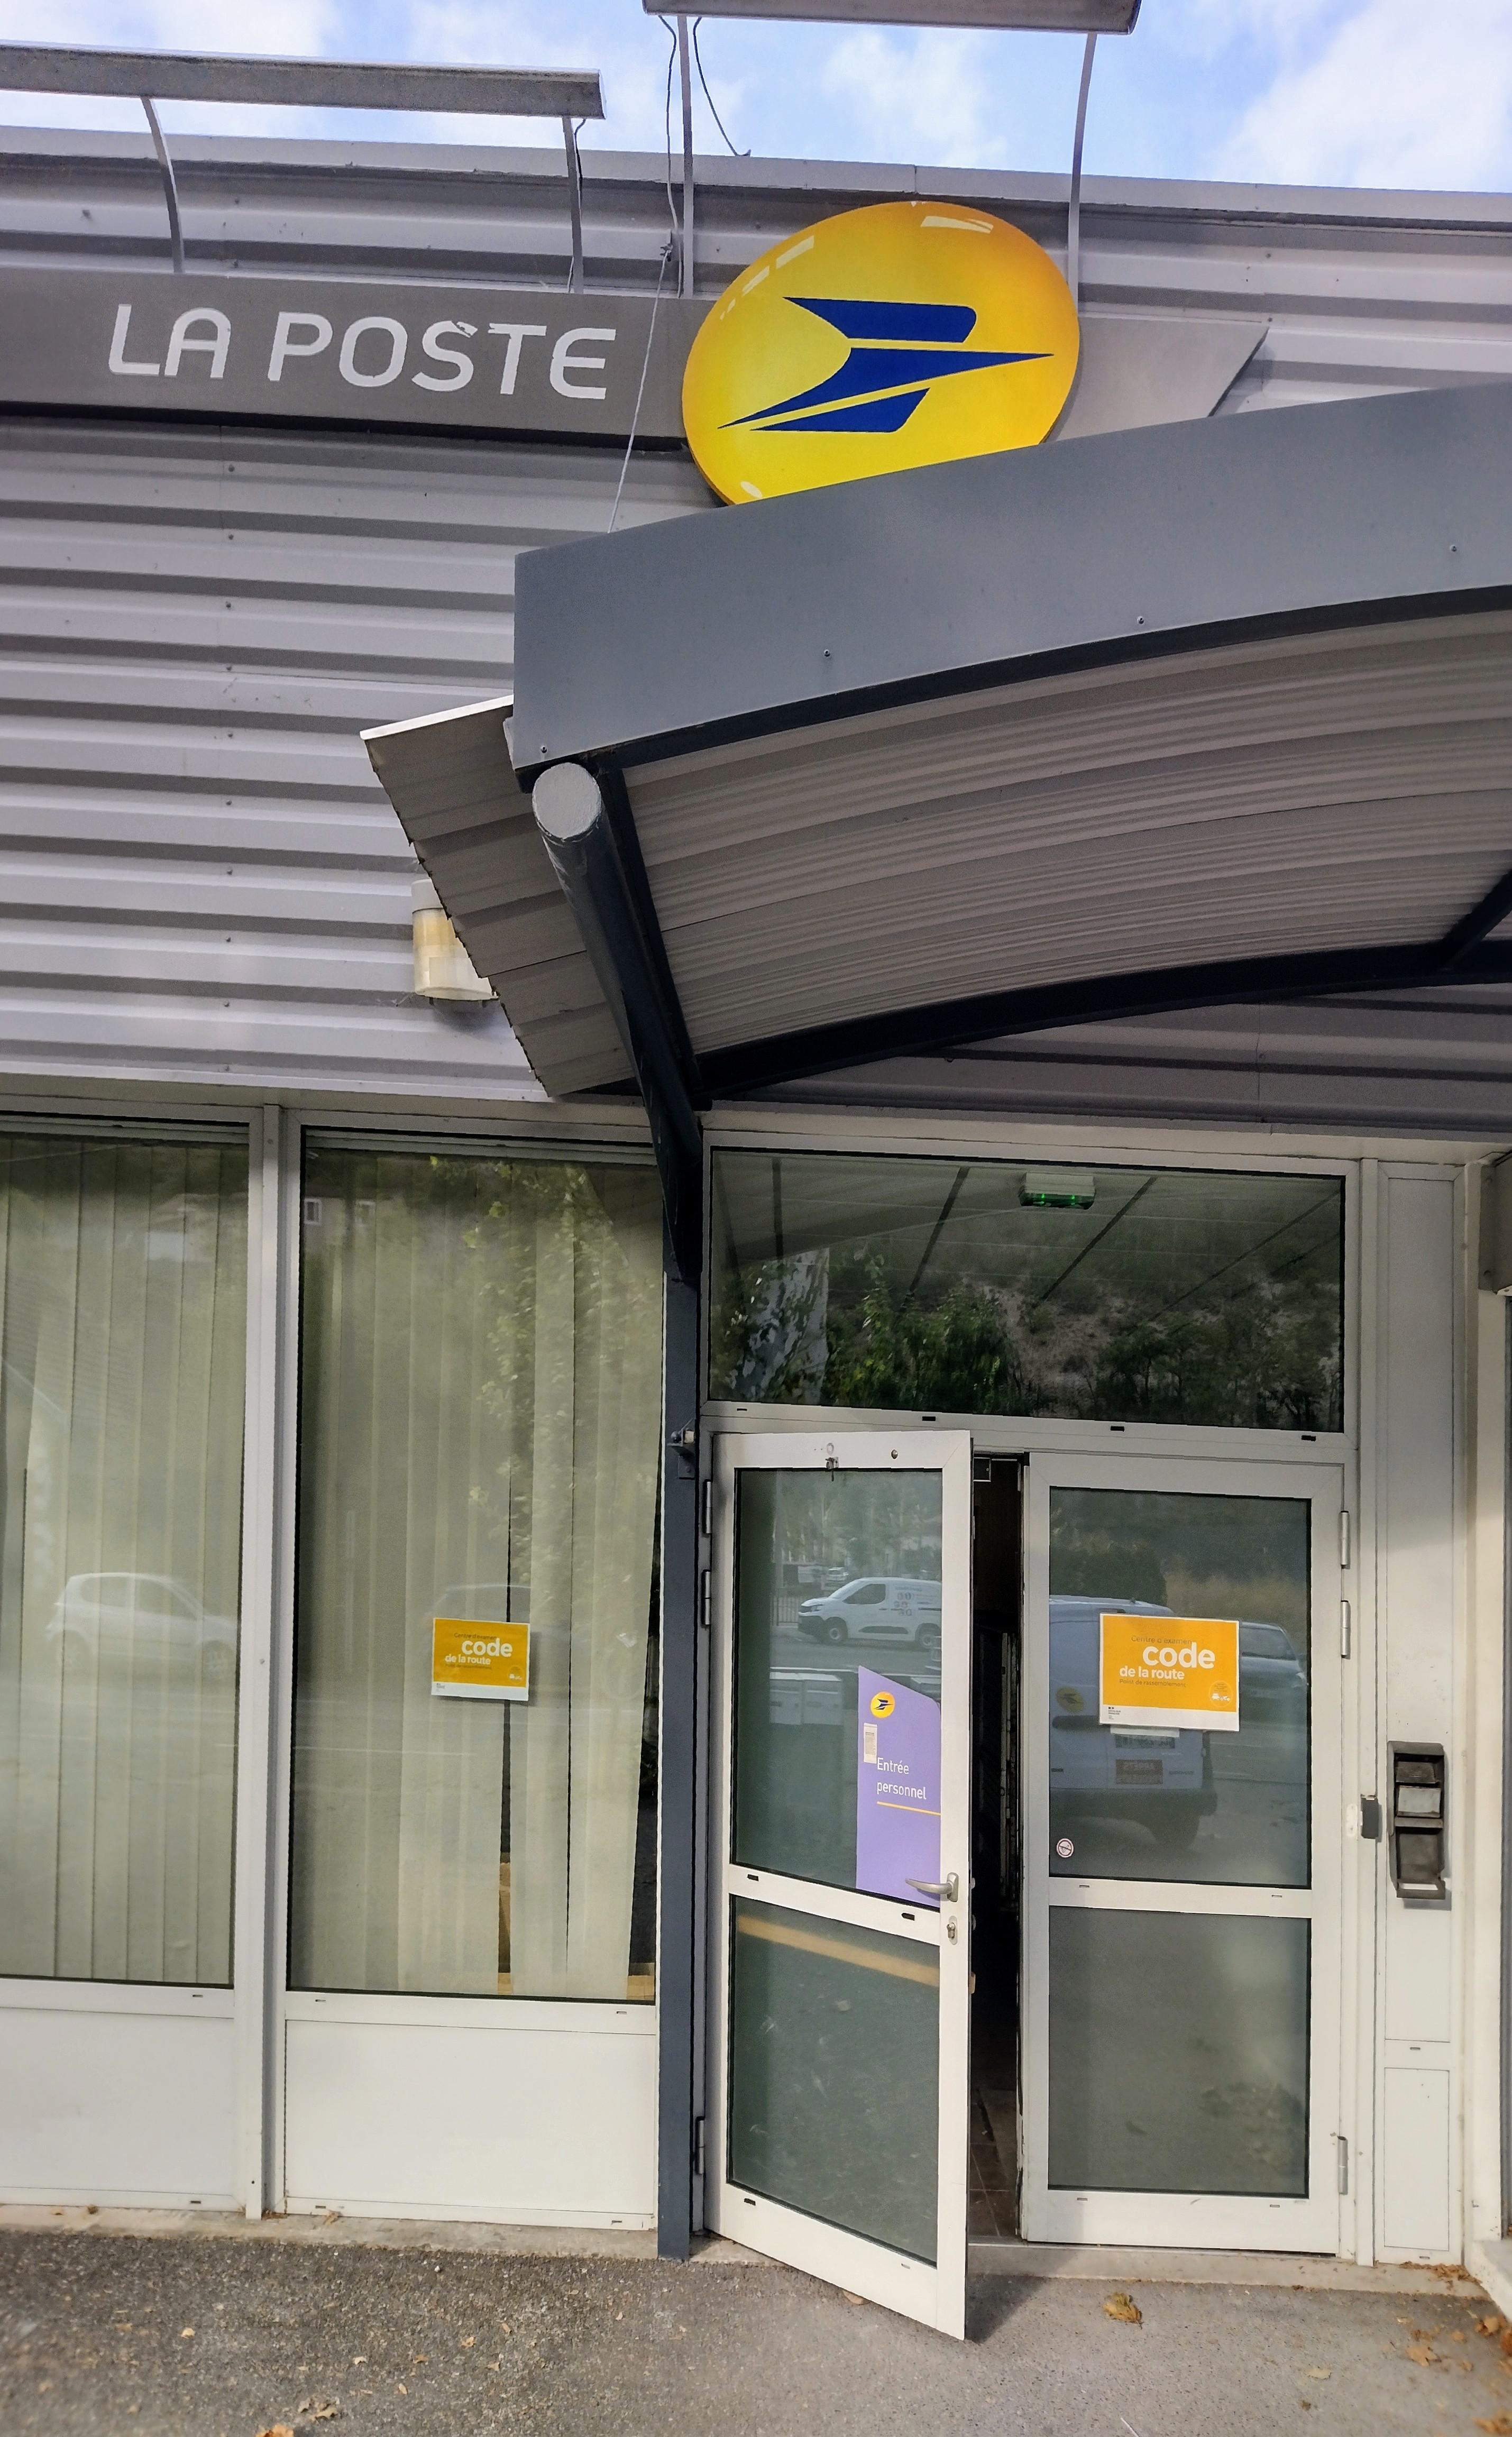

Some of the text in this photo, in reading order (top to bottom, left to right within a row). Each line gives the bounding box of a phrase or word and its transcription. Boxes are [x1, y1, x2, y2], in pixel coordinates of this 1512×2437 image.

[108, 304, 616, 400] LA POSTE
[461, 1637, 513, 1657] code
[1142, 1642, 1215, 1669] code
[445, 1654, 491, 1665] de la route
[1119, 1665, 1185, 1680] de la route
[877, 1757, 909, 1774] Entrée
[877, 1781, 927, 1800] personnel
